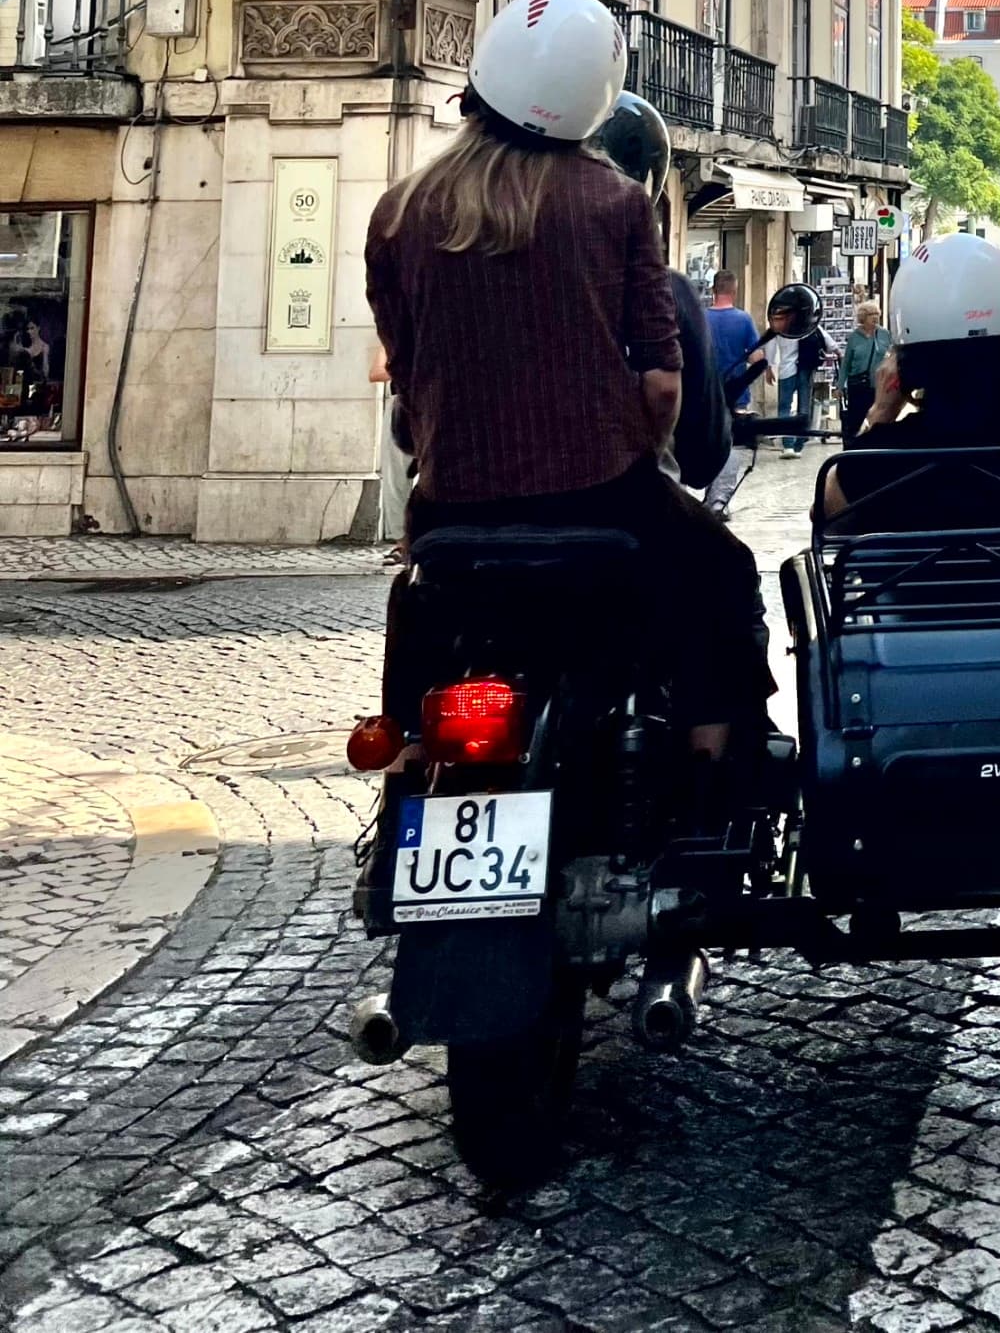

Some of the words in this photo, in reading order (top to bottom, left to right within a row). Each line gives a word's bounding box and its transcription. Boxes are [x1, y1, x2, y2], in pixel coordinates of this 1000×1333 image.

[295, 194, 315, 207] 50
[845, 226, 874, 238] ROSSIO
[844, 238, 874, 250] HOSTEL
[455, 798, 497, 843] 81
[405, 828, 416, 842] P
